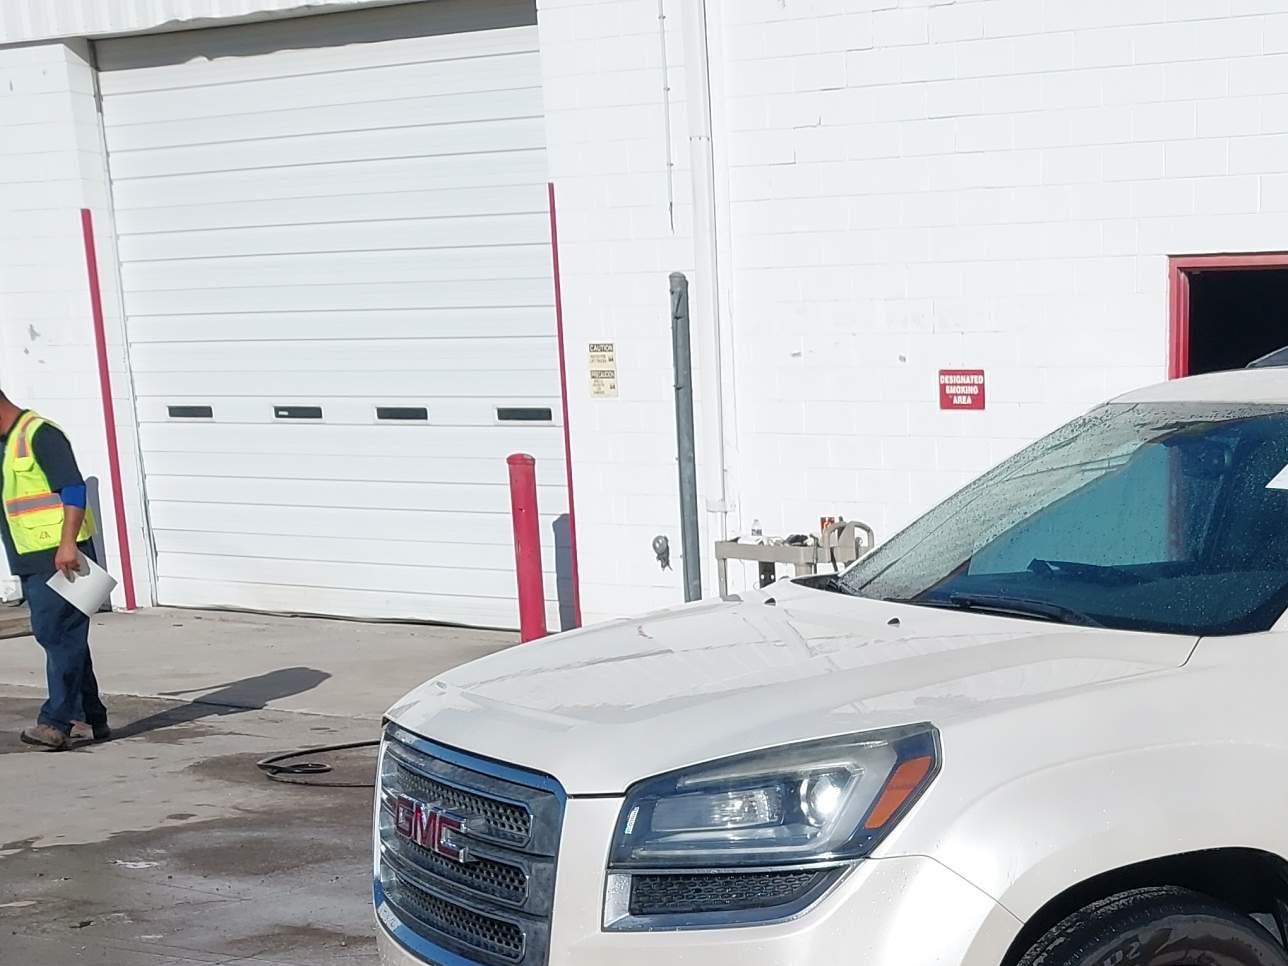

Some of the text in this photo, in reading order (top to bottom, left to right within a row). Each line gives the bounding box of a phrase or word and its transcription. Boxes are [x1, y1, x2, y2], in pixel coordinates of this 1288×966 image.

[940, 375, 984, 384] DESIGNATED
[945, 385, 979, 394] SMOKING
[953, 395, 972, 404] AREA
[394, 794, 467, 863] GMC
